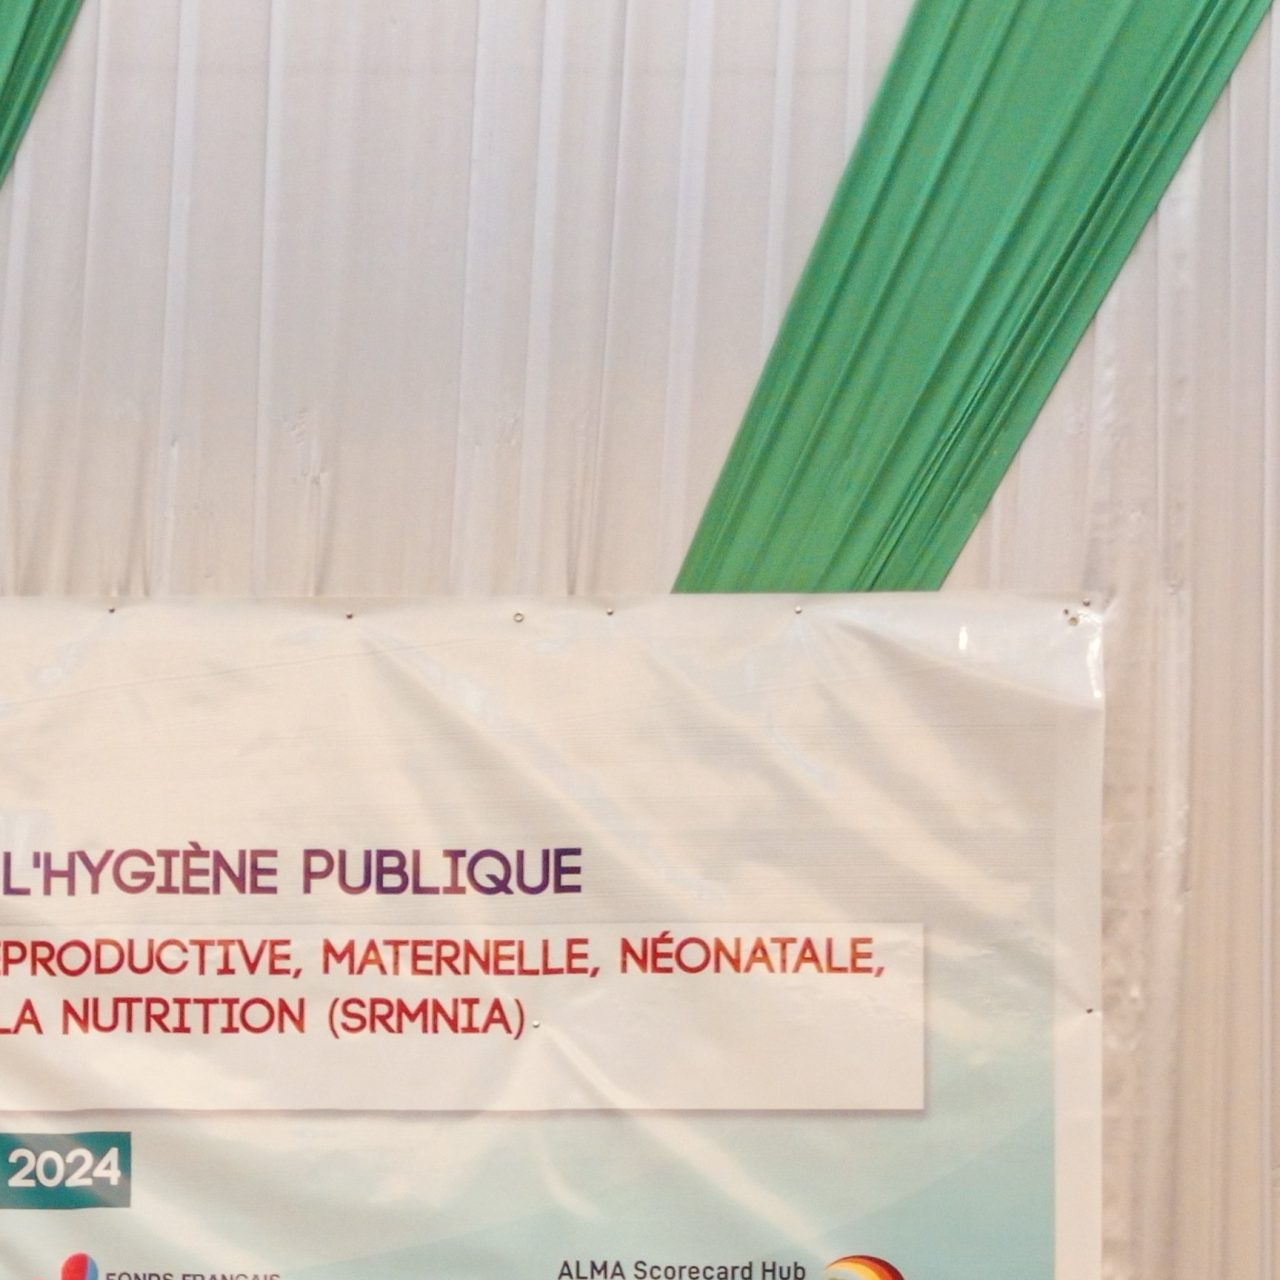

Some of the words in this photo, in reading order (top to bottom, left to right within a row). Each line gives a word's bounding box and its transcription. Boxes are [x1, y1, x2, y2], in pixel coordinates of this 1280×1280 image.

[3, 841, 278, 896] L'HYGIÈNE
[303, 848, 582, 895] PUBLIQUE
[323, 938, 600, 977] MATERNELLE,
[621, 931, 885, 977] NÉONATALE,
[63, 997, 305, 1034] NUTRITION
[329, 998, 525, 1040] (SRMNIA)
[8, 1147, 121, 1187] 2024
[557, 1260, 626, 1280] ALMA
[633, 1260, 753, 1280] Scorecard
[761, 1261, 806, 1280] Hub
